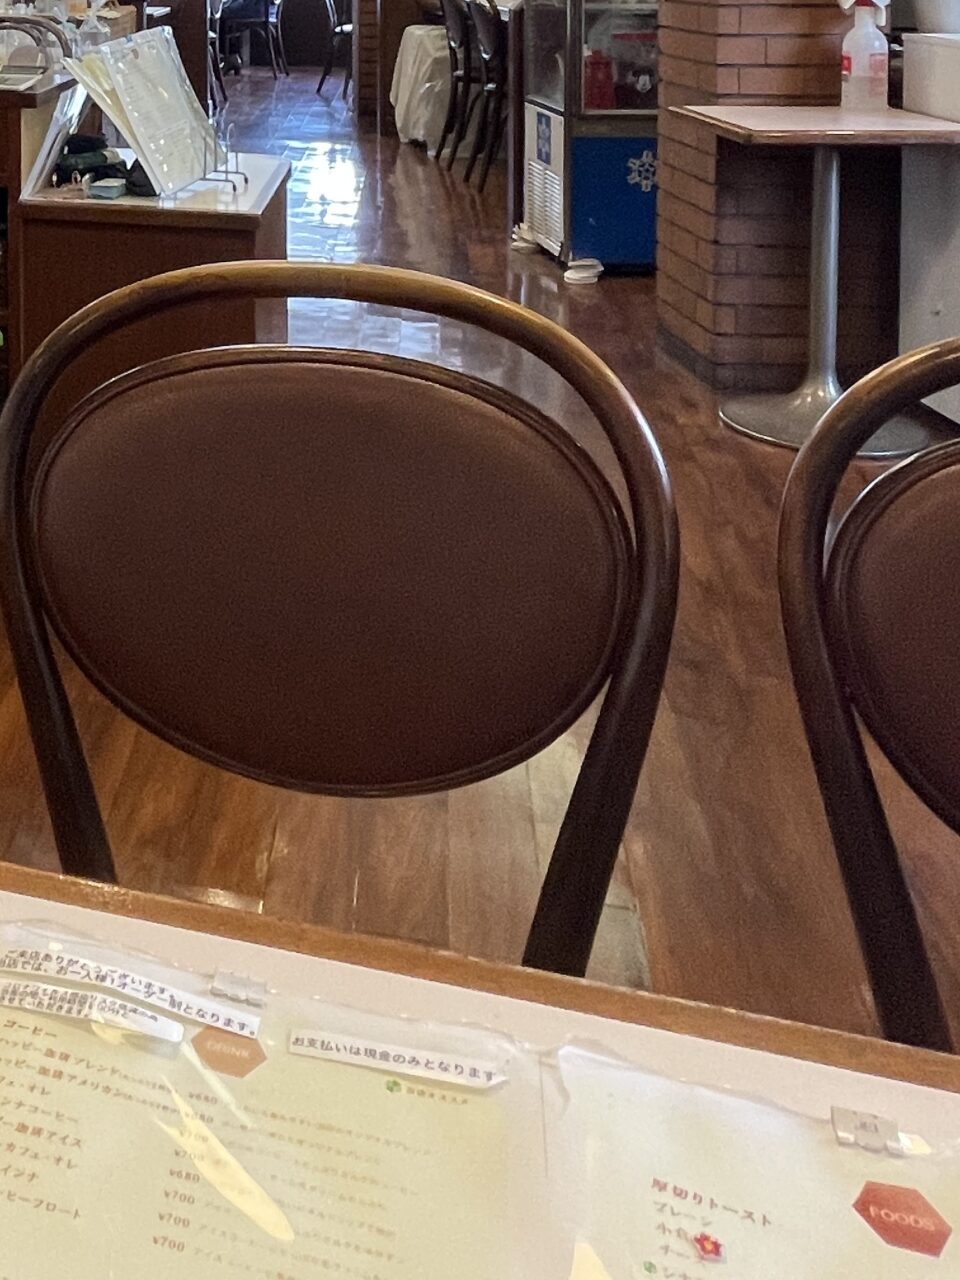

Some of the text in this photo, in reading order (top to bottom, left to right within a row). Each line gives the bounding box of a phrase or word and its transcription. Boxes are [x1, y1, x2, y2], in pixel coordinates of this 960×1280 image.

[3, 1019, 58, 1038] コーヒー
[291, 1036, 497, 1082] お支払いは現金のみとなります
[651, 1176, 772, 1227] 厚切りトースト
[868, 1204, 936, 1232] FOODS
